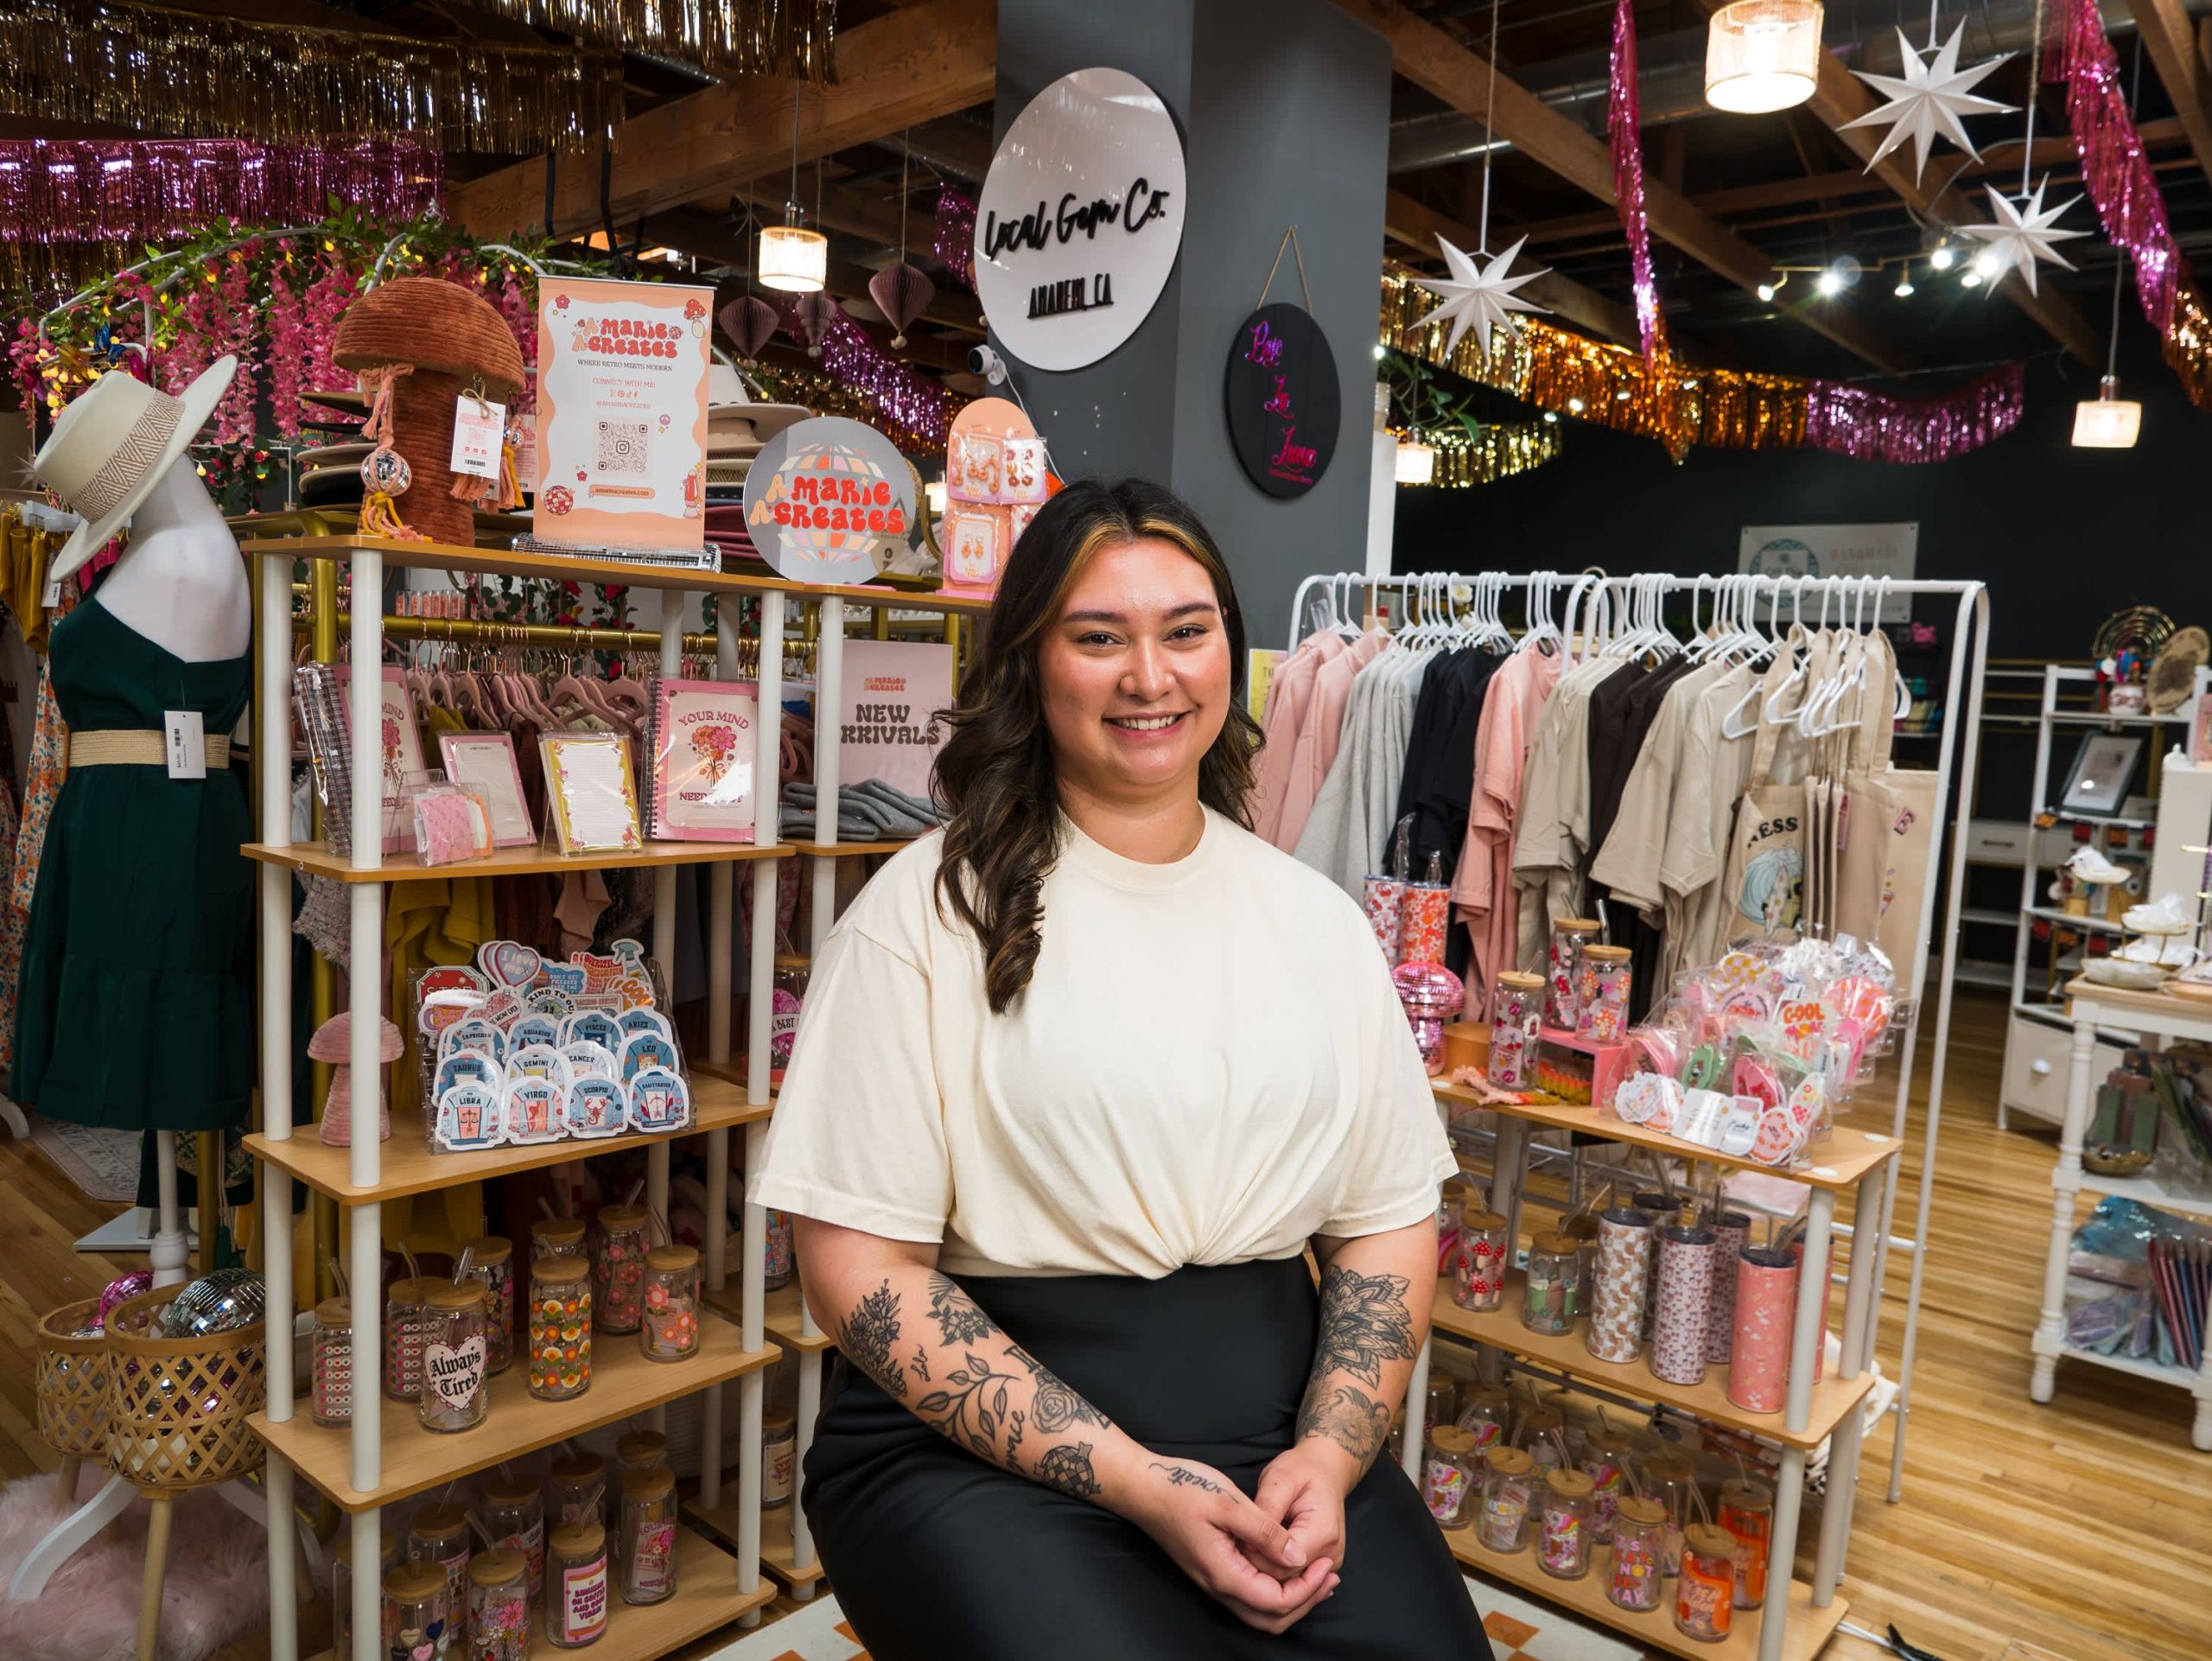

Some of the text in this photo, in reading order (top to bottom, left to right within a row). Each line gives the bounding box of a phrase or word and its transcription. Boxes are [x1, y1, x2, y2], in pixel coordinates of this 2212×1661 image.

[984, 200, 1052, 262] Local
[1123, 177, 1170, 232] Co.
[1095, 273, 1114, 305] CA
[577, 359, 602, 367] WHERE
[602, 360, 623, 369] RETRO
[623, 361, 645, 371] MEETS
[592, 377, 624, 386] CONNECT
[625, 379, 643, 388] WITH
[855, 703, 911, 723] NEW
[678, 710, 750, 730] YOUR MIND
[840, 725, 940, 745] RRIVALS
[528, 989, 551, 1003] KIND
[554, 990, 566, 999] TO
[566, 999, 575, 1015] OU
[507, 1005, 519, 1016] EVER
[1783, 1003, 1826, 1024] COOL
[628, 1021, 649, 1029] ARIES
[778, 1017, 795, 1030] BEST
[523, 1029, 551, 1038] AQUARIUS
[642, 1045, 657, 1053] LEO
[569, 1055, 595, 1064] CANCER
[454, 1064, 482, 1073] TAURUS
[459, 1097, 481, 1105] LIBRA
[524, 1091, 549, 1100] VIRGO
[429, 1351, 481, 1378] Always
[439, 1371, 480, 1397] Tired
[573, 1603, 589, 1613] AND
